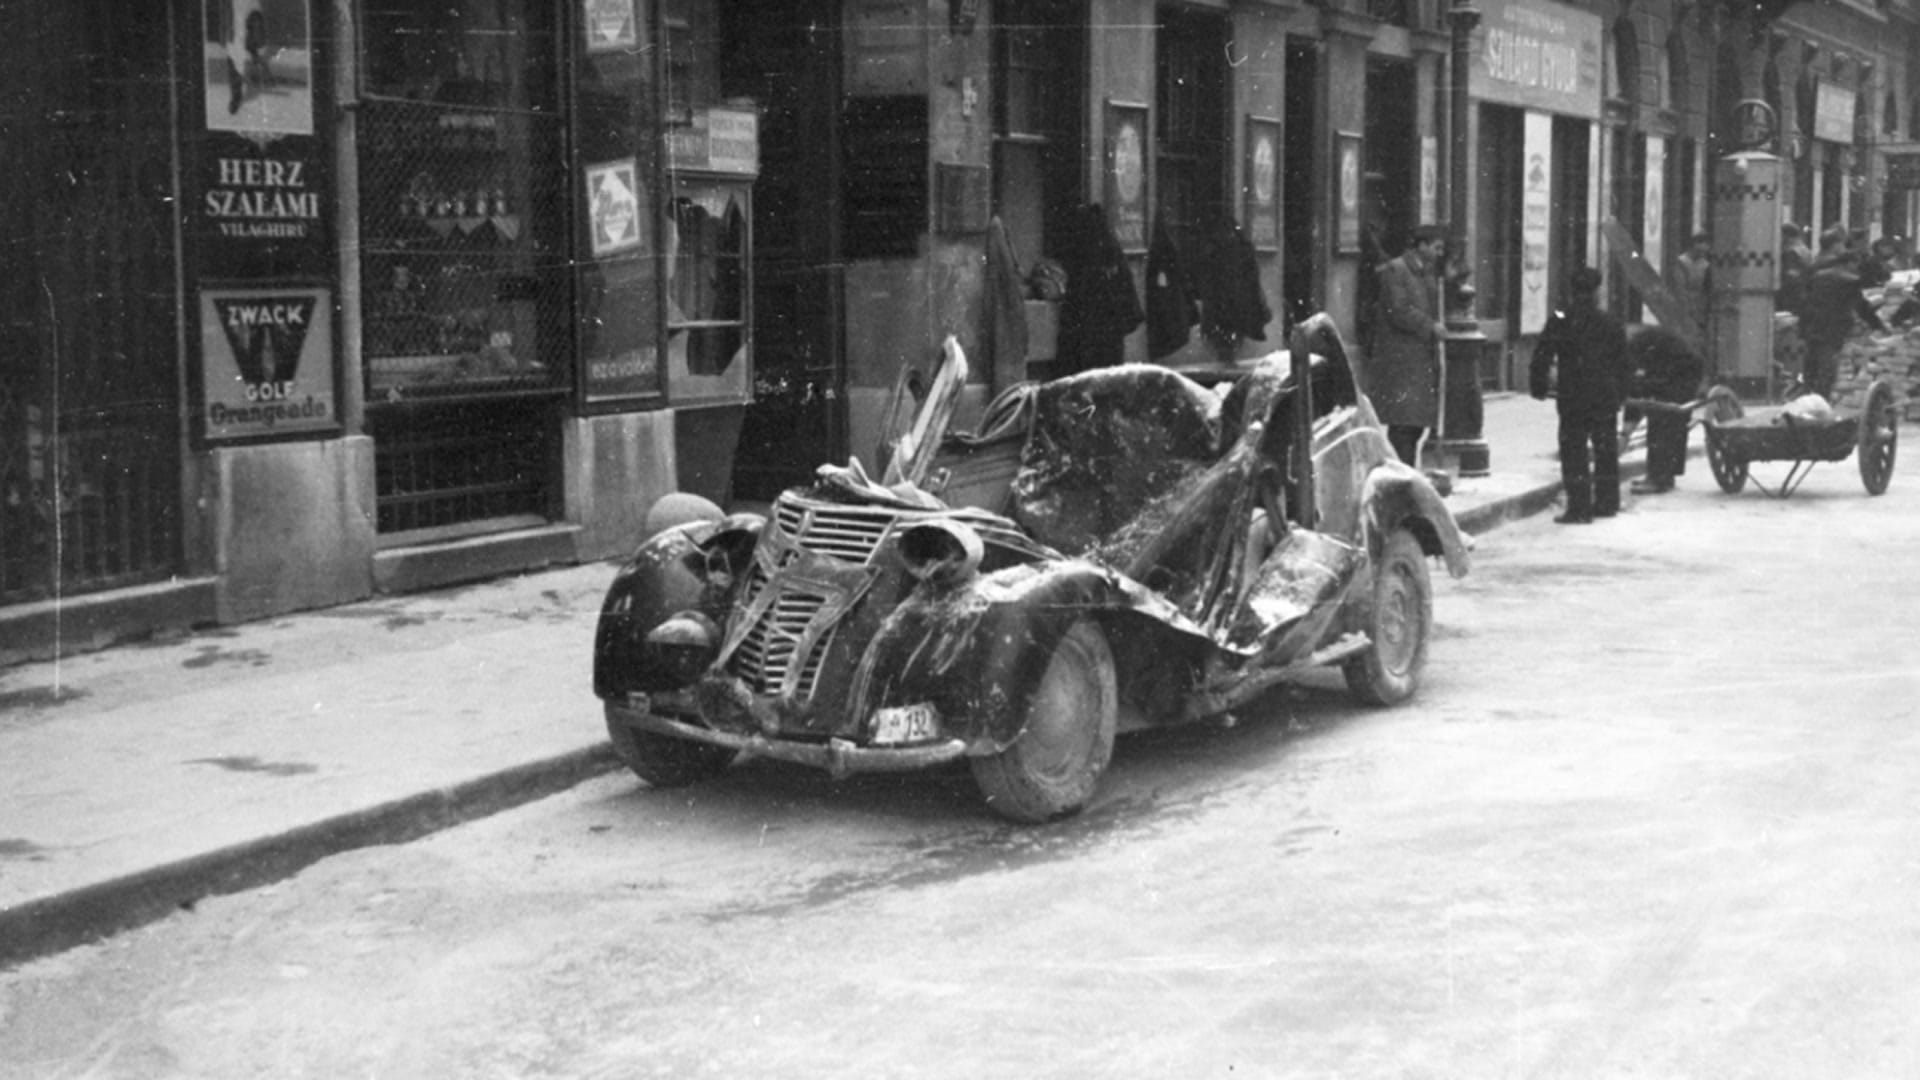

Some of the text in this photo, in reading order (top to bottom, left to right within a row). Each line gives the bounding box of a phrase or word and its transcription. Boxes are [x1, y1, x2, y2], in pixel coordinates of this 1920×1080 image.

[219, 158, 304, 187] HERZ
[228, 305, 303, 326] ZWACK
[246, 382, 294, 401] GOLF
